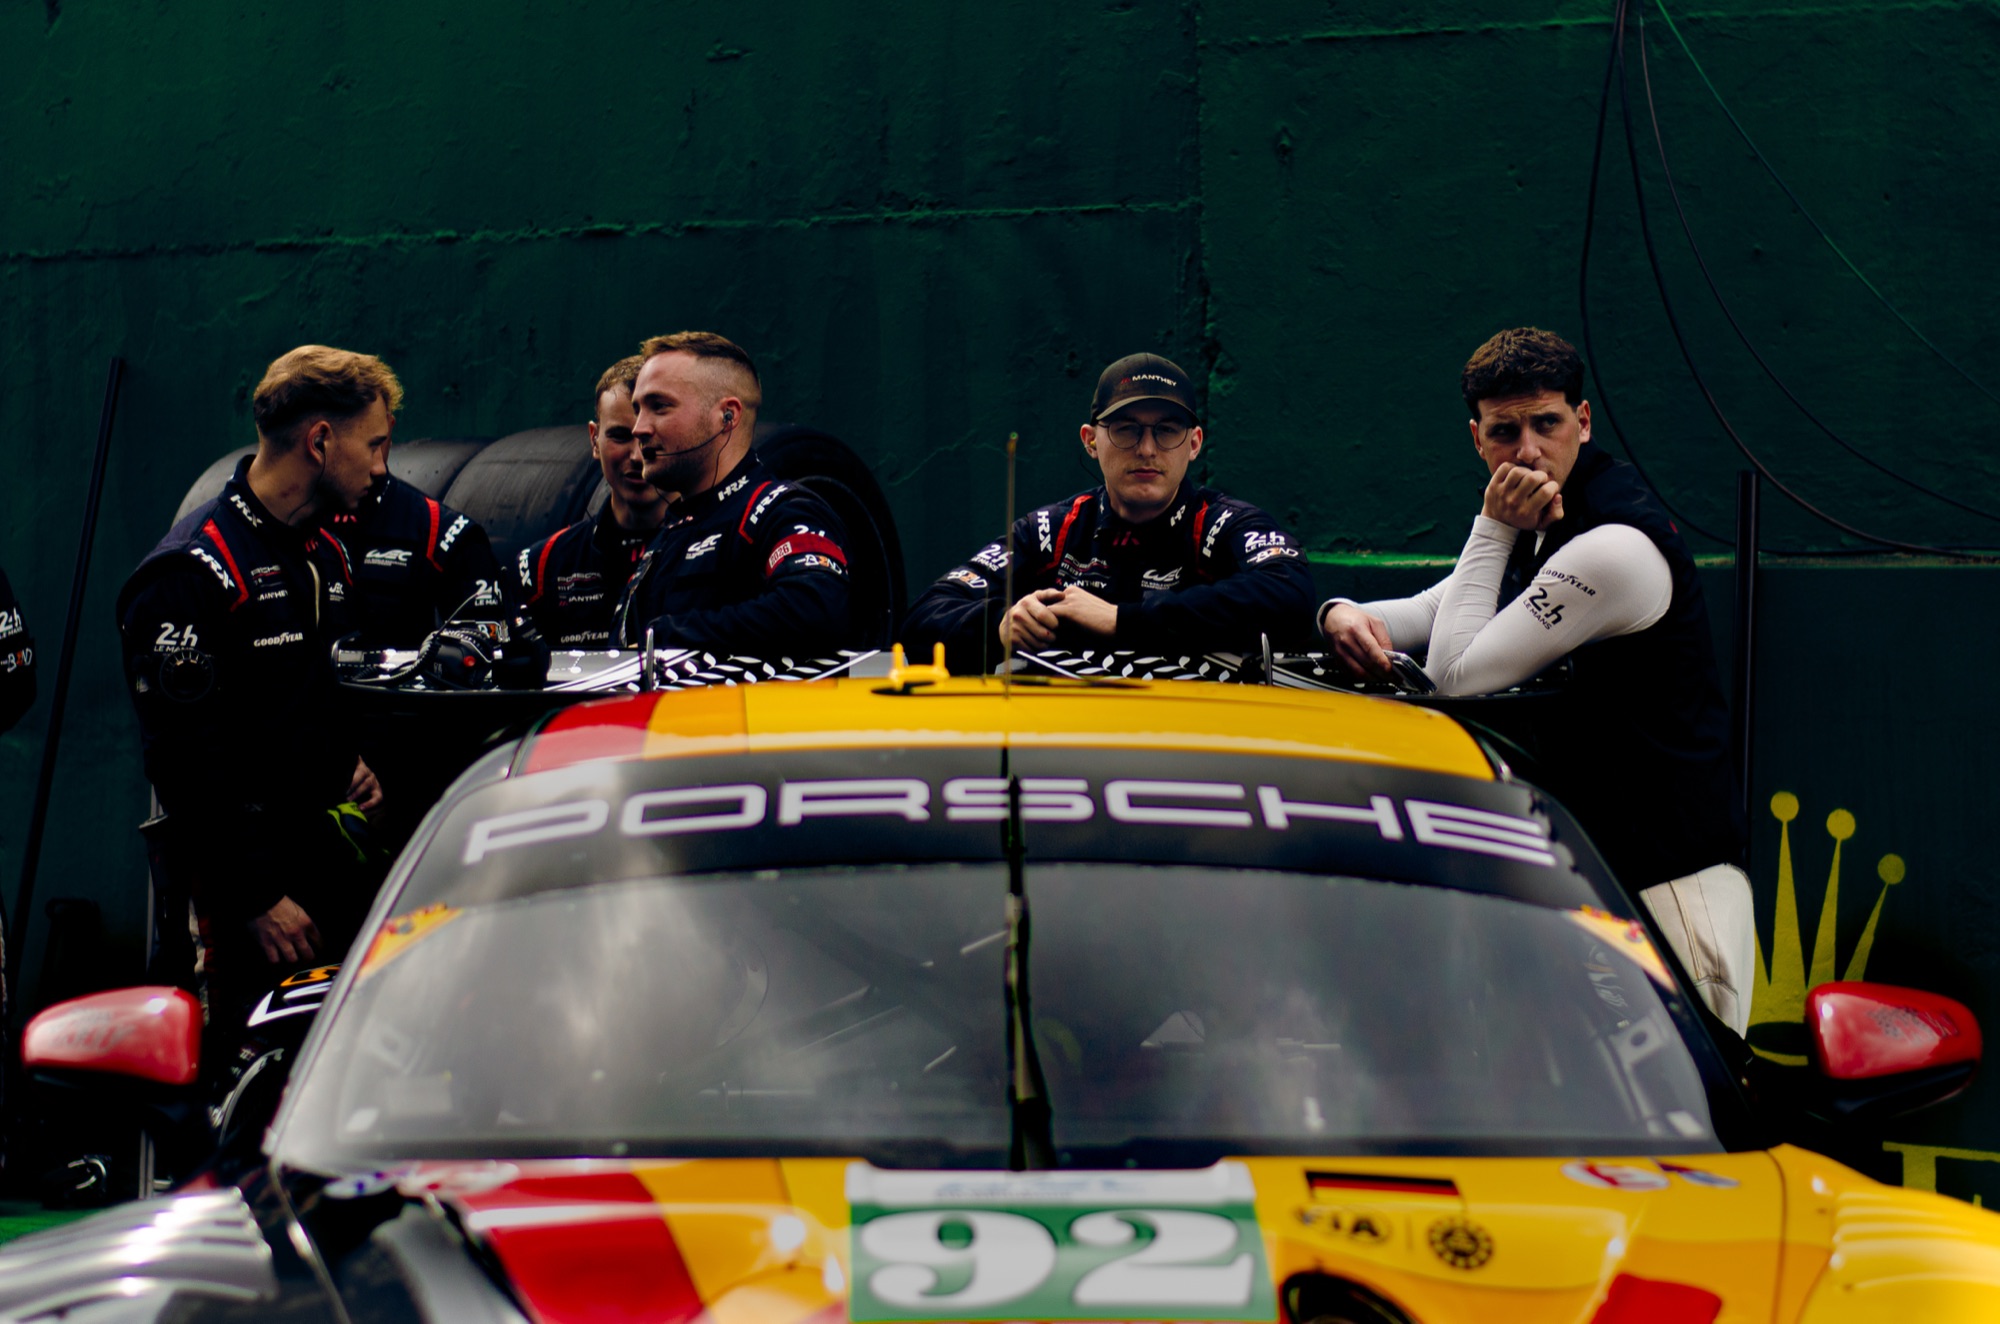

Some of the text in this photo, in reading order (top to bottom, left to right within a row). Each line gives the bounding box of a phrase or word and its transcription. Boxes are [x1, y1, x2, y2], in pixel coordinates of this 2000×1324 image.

[1132, 374, 1177, 387] MANTHEY
[718, 475, 749, 501] HRX
[750, 484, 788, 524] HRX
[230, 494, 263, 528] HRX
[1170, 504, 1186, 527] HR
[440, 514, 469, 552] HRX
[1037, 510, 1053, 553] HRX
[1202, 509, 1233, 558] HRX
[190, 547, 235, 590] HRX
[518, 548, 533, 587] HRX
[1528, 587, 1566, 626] 24h
[1529, 608, 1553, 630] MANS
[463, 776, 1558, 867] PORSCHE
[860, 1208, 1256, 1310] 92
